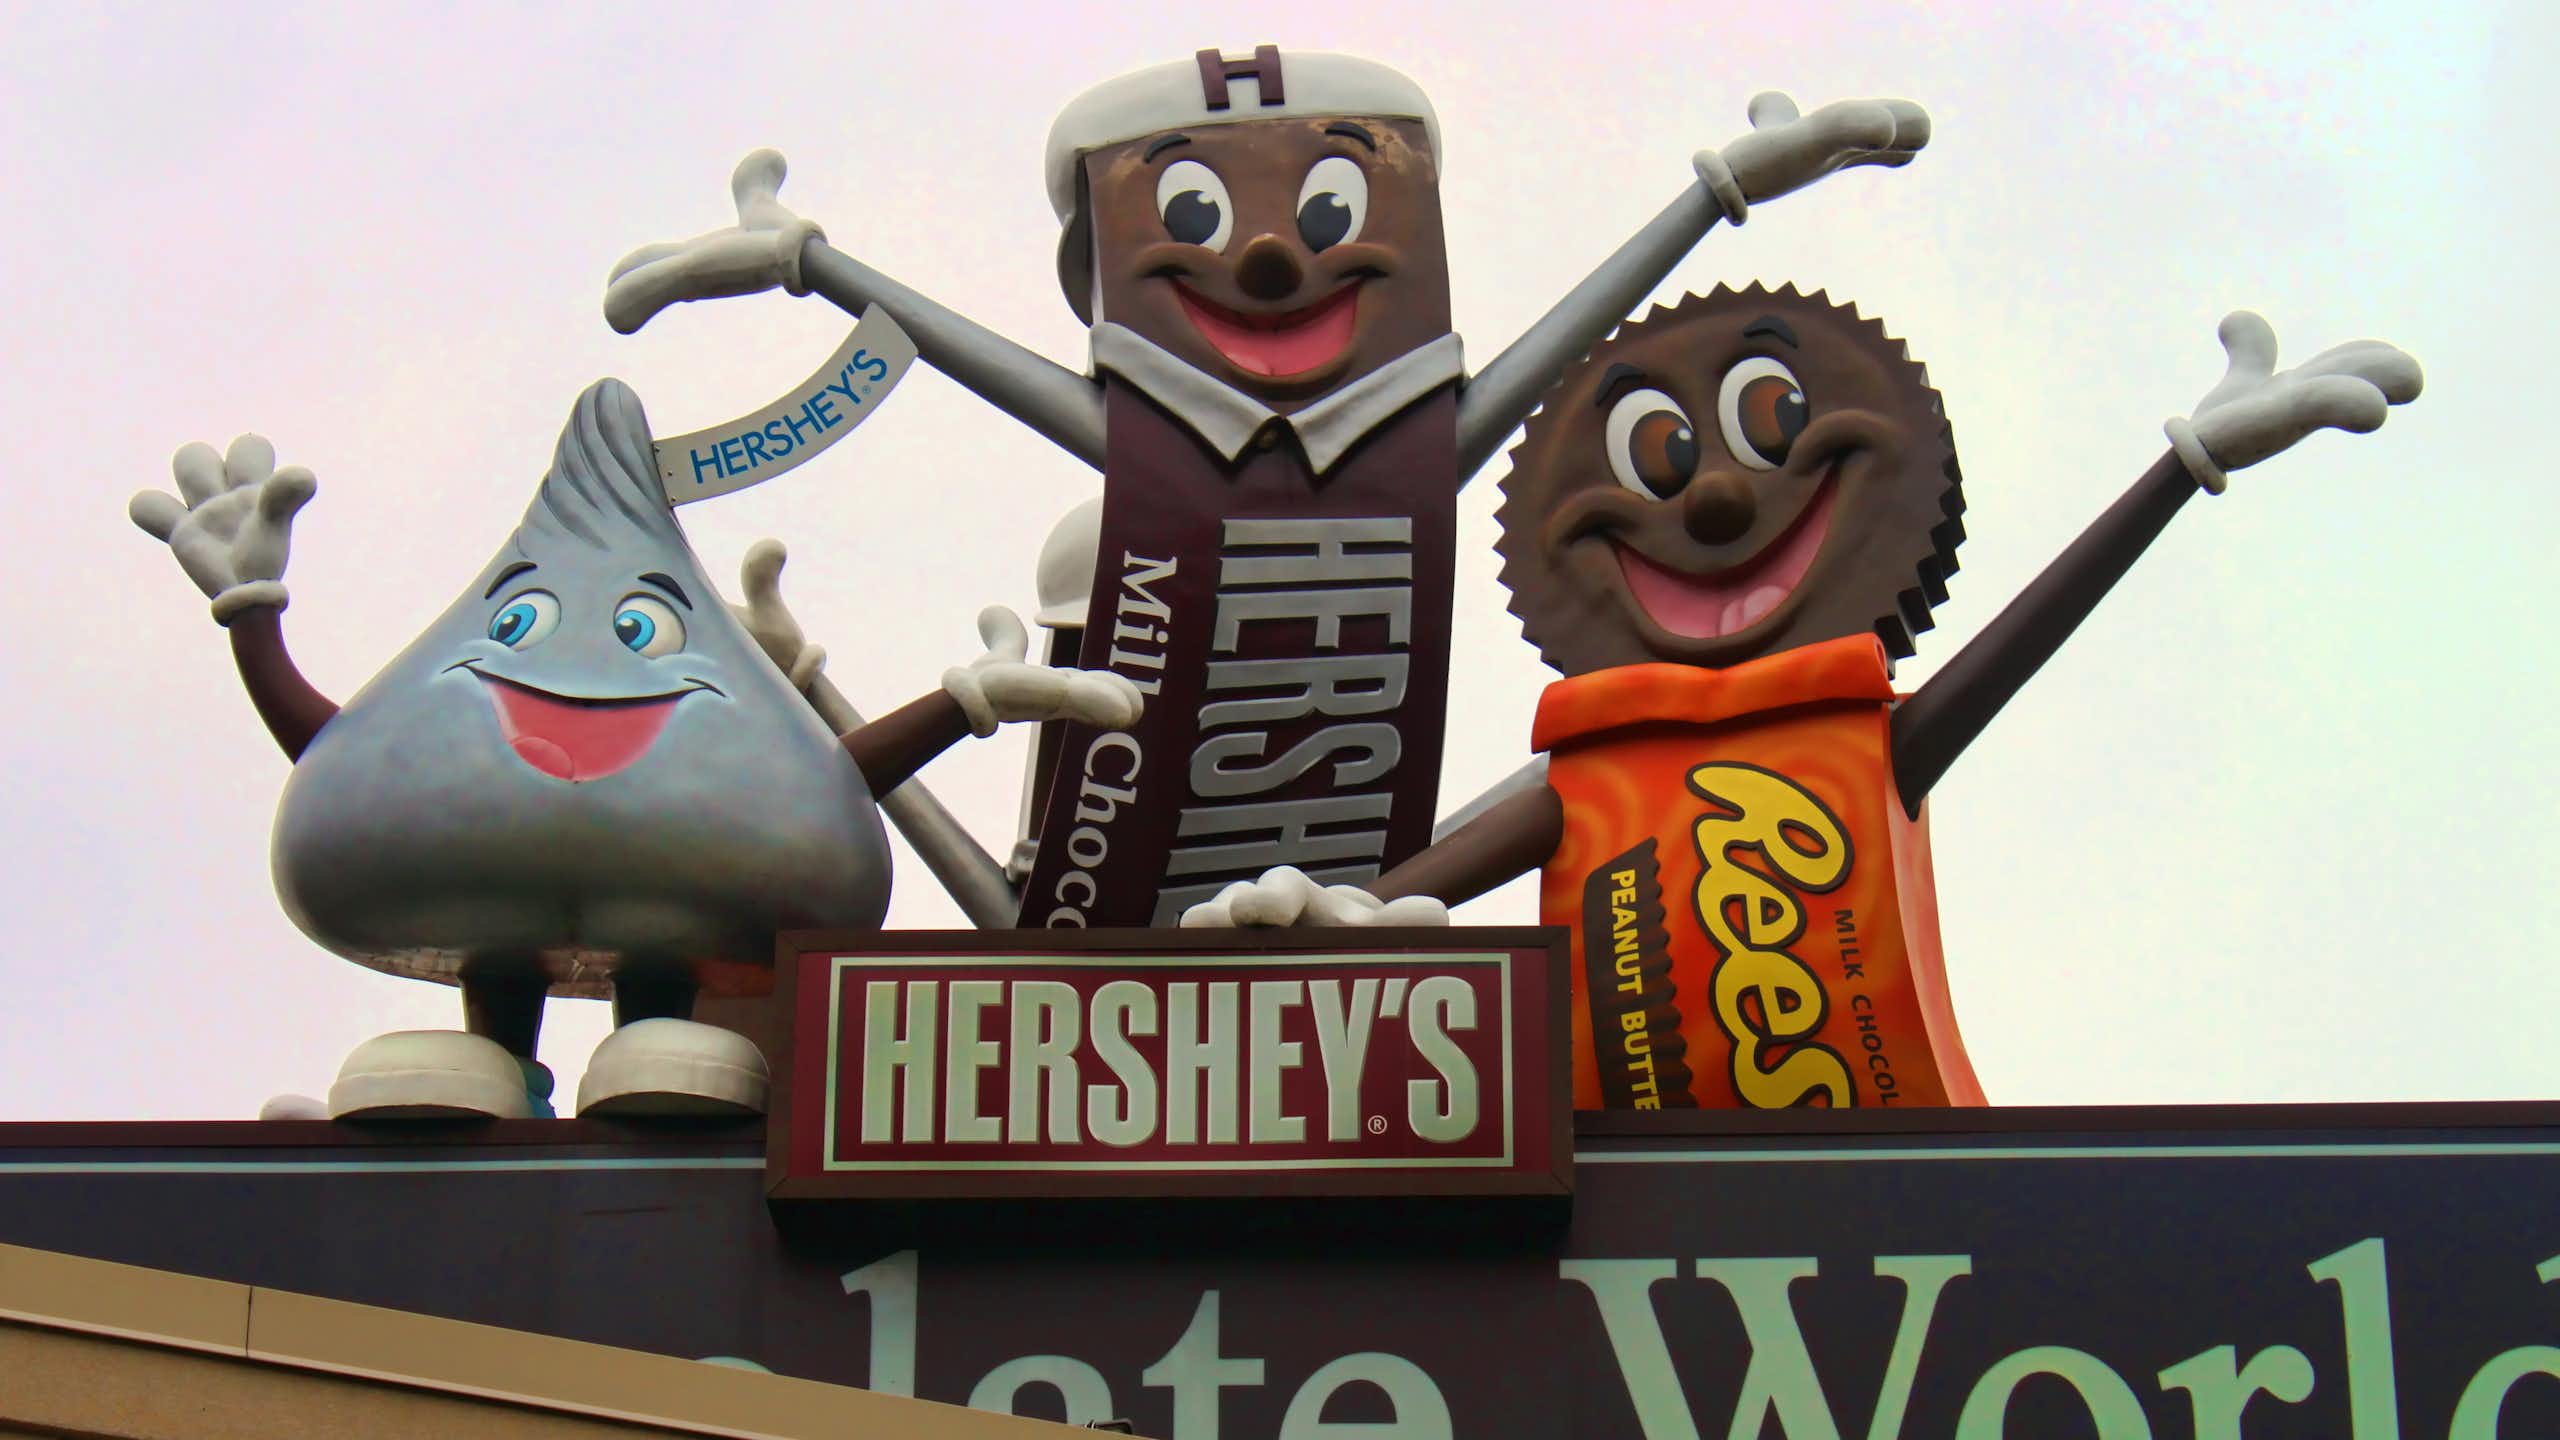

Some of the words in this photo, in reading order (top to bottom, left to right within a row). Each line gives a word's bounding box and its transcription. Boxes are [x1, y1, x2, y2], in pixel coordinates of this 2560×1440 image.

[1196, 44, 1285, 111] H
[690, 348, 888, 484] HERSHEY'S
[1610, 868, 1643, 995] PEANUT
[860, 975, 1480, 1146] HERSHEY'S
[1621, 1010, 1661, 1110] BUTTE
[1833, 908, 1865, 981] MILK
[1851, 993, 1900, 1104] CHOCOL
